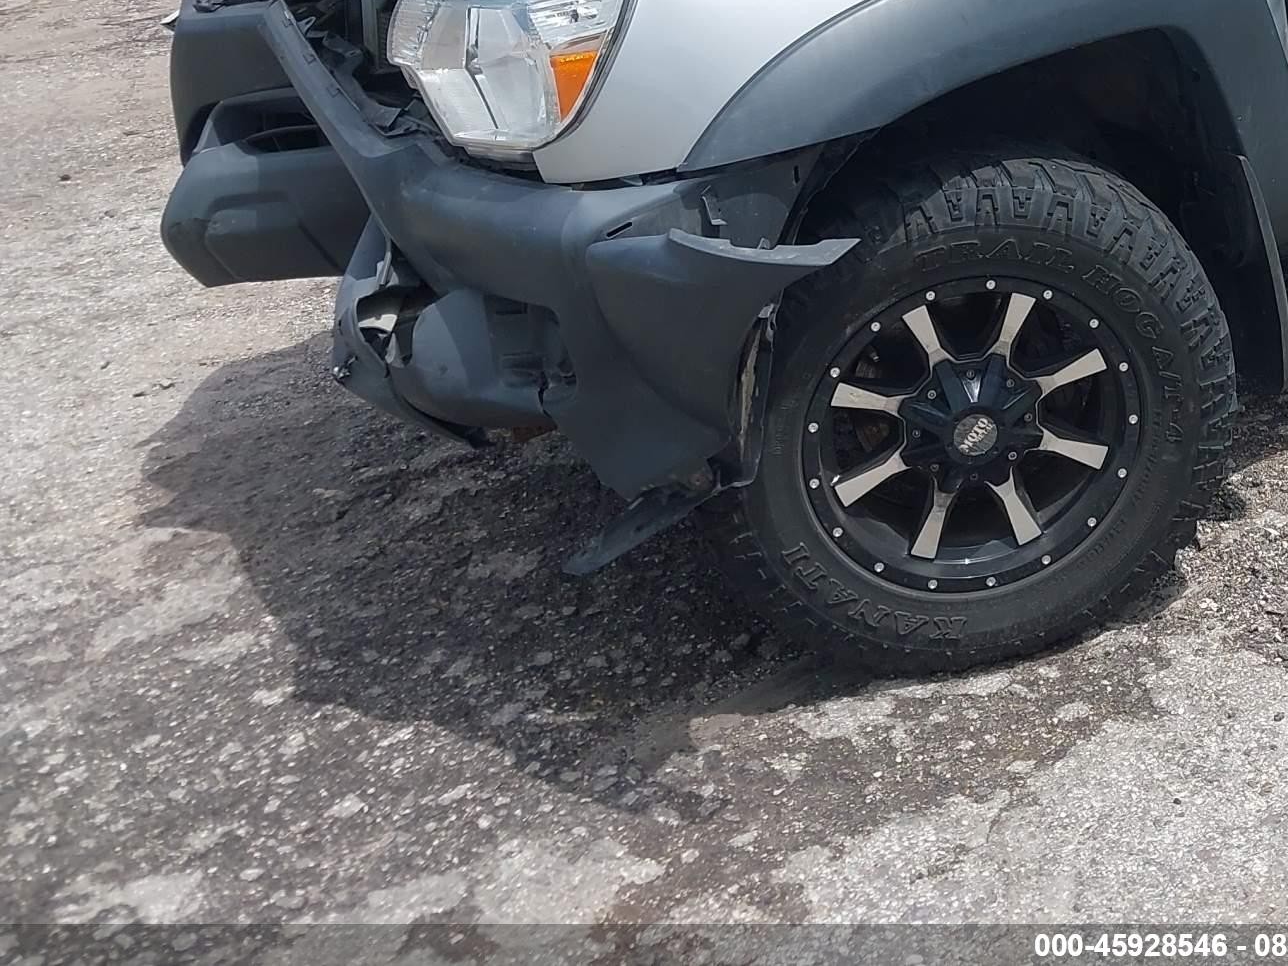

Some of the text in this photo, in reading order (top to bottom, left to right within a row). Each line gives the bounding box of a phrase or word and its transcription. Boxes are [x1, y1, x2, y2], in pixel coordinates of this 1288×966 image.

[914, 237, 1076, 275] TRAIL
[1081, 264, 1164, 340] HOG
[782, 541, 969, 641] KANATI
